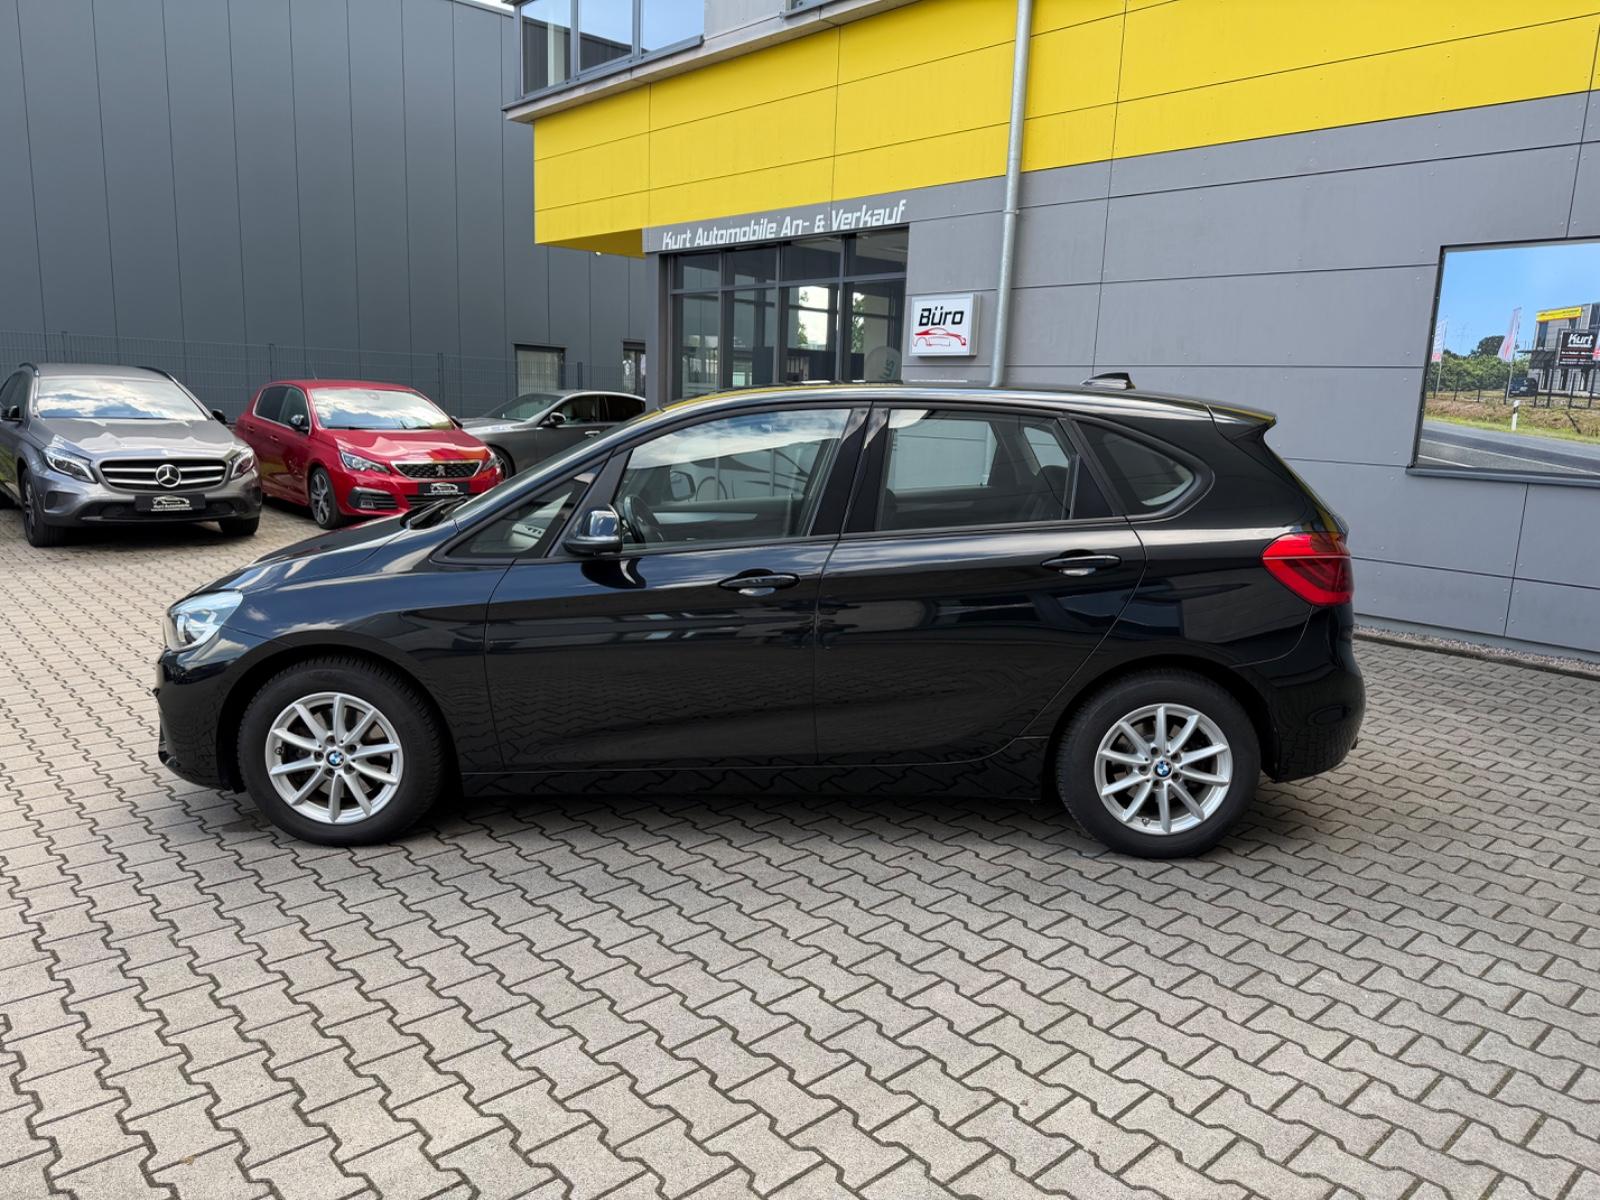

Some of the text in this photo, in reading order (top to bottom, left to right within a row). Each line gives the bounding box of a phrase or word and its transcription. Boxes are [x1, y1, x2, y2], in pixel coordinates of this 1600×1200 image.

[662, 199, 906, 250] Kurt Automobile An- & Verkauf
[918, 306, 964, 327] Büro
[1568, 333, 1593, 344] Kurt
